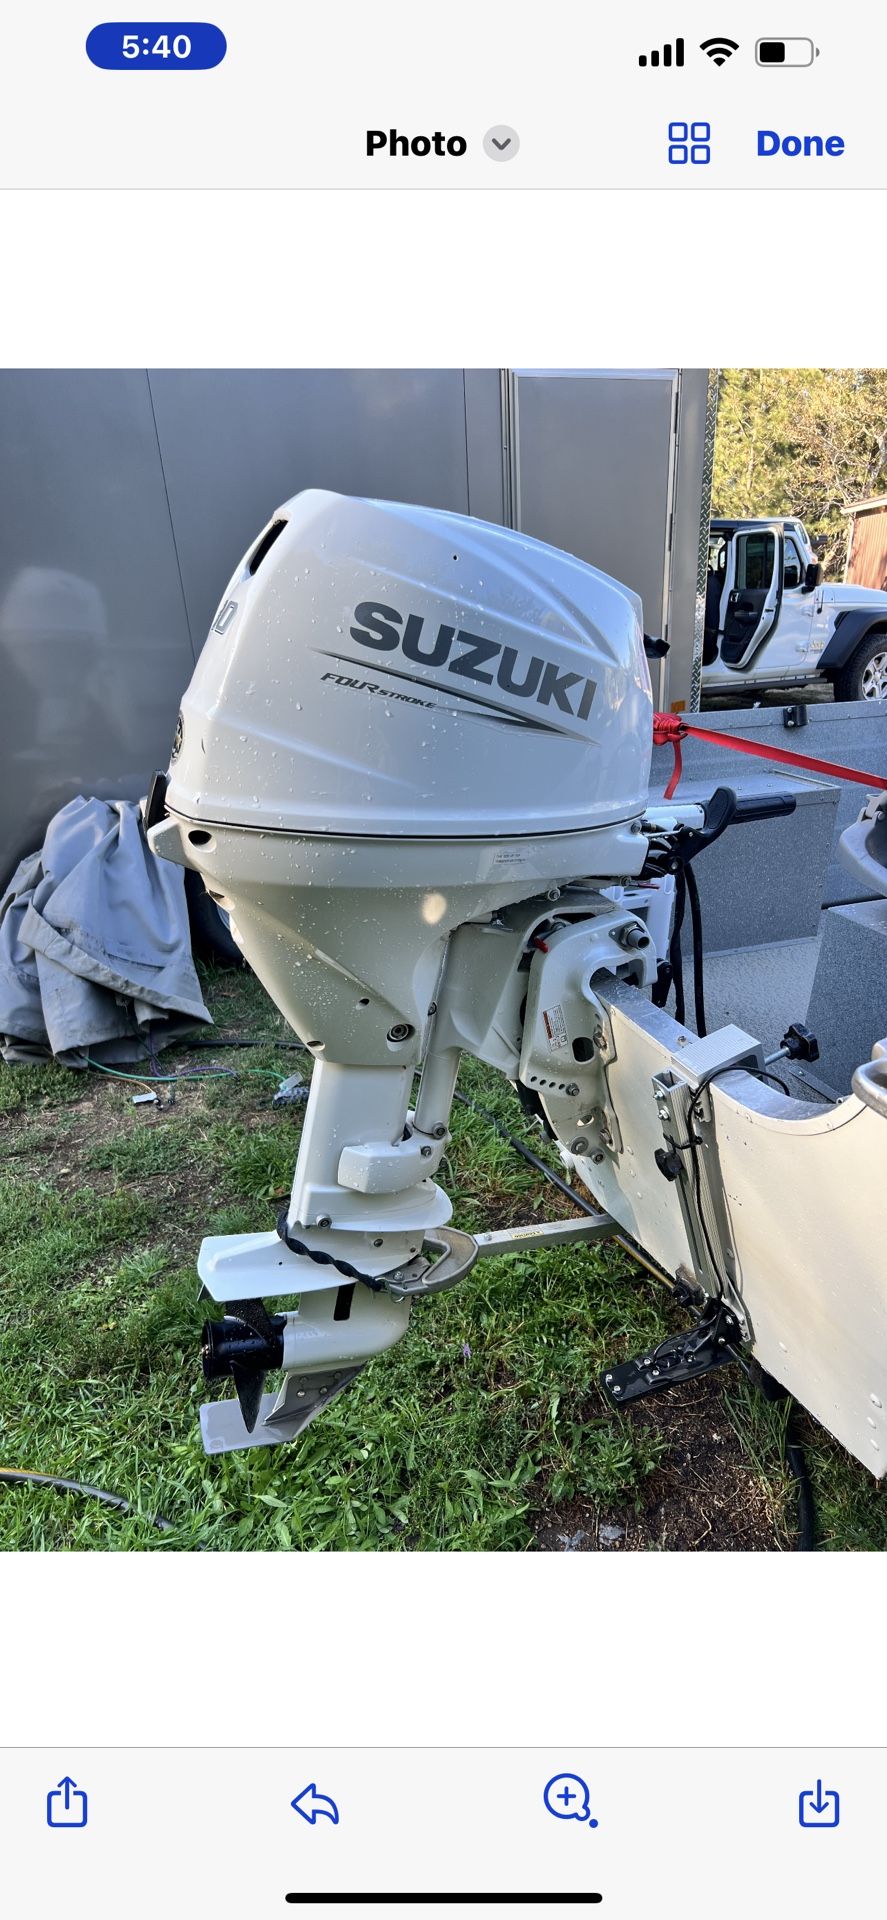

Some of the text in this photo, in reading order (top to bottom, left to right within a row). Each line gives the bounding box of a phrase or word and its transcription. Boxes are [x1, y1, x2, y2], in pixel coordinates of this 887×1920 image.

[320, 672, 437, 709] FOUR STROKE
[350, 601, 597, 720] SUZUKI
